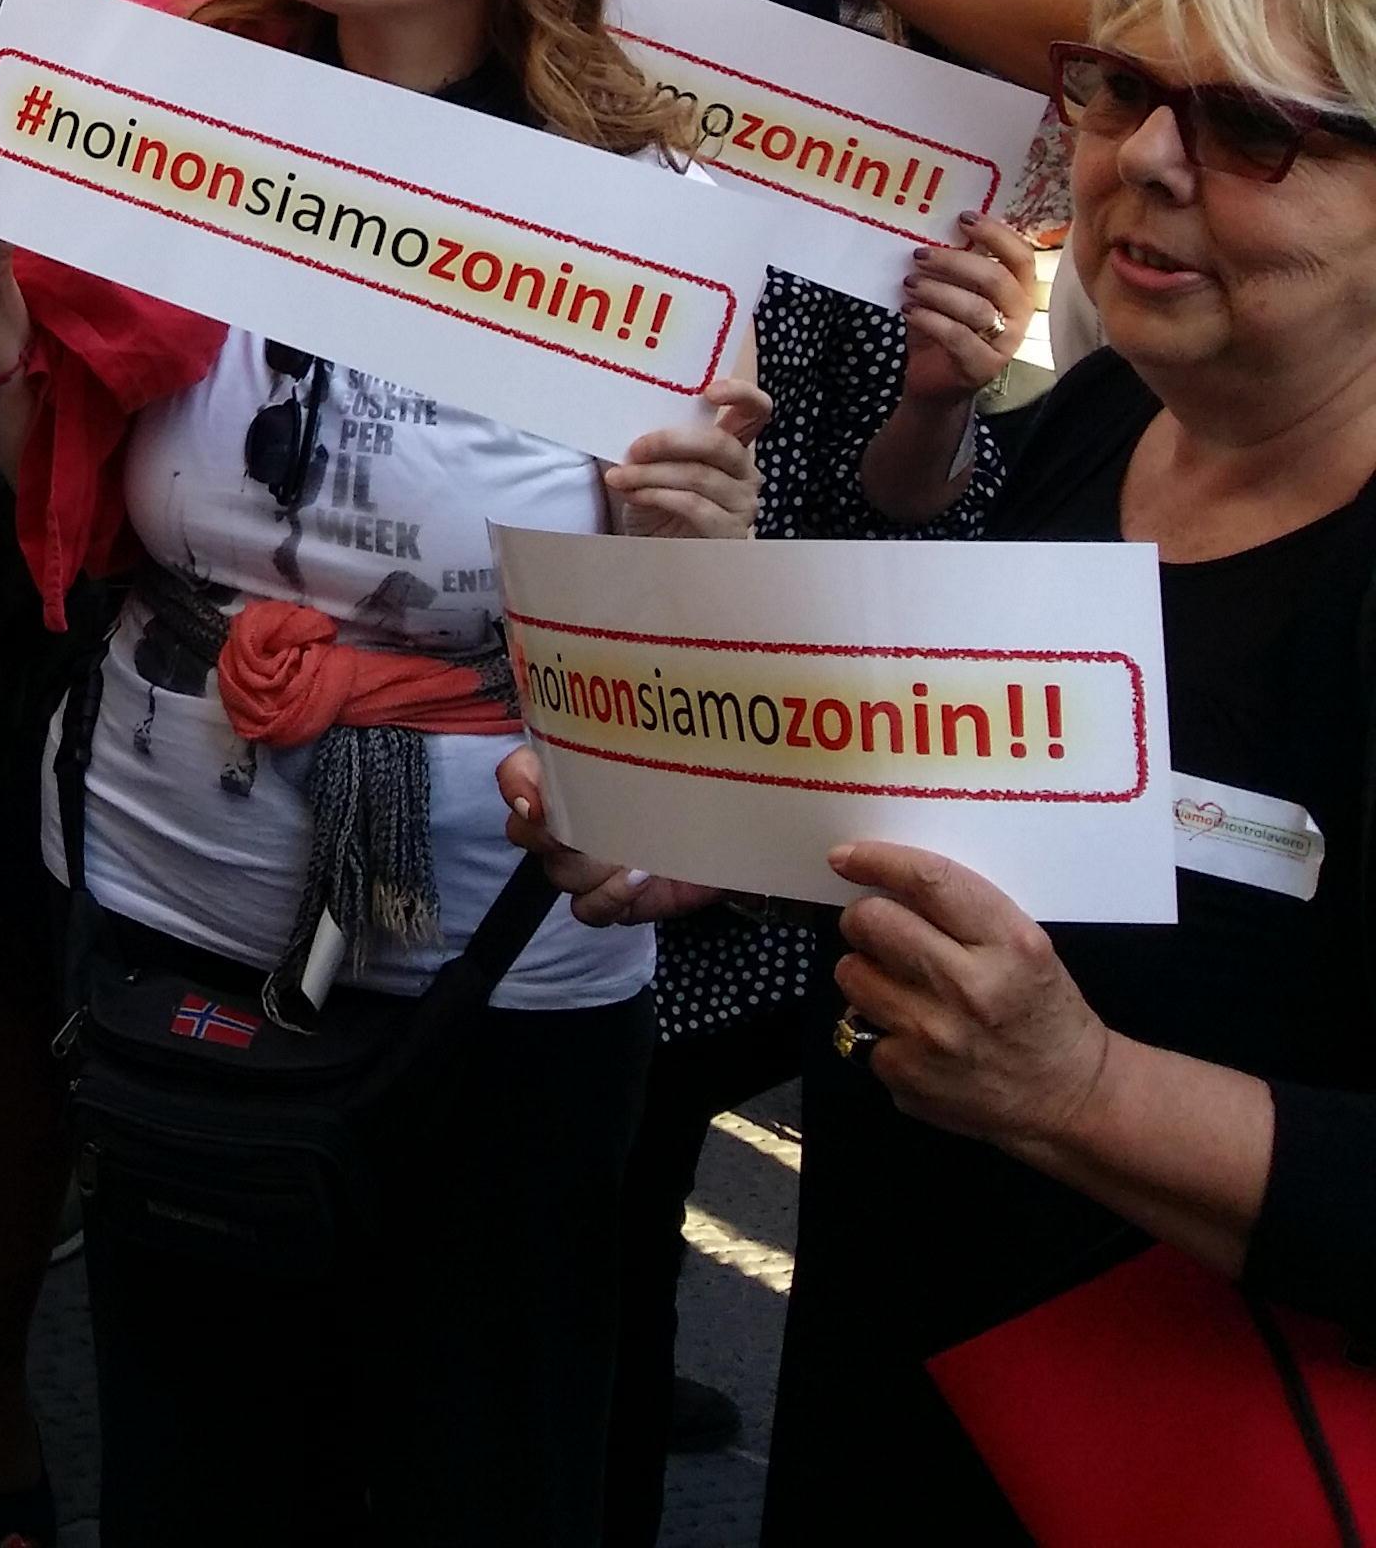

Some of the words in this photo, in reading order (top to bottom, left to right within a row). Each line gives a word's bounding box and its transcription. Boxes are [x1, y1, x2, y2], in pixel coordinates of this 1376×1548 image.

[16, 84, 674, 349] #noinonsiamozonin!!
[339, 419, 394, 455] PER
[331, 453, 378, 512] IL
[316, 508, 422, 561] WEEK
[442, 569, 496, 592] END
